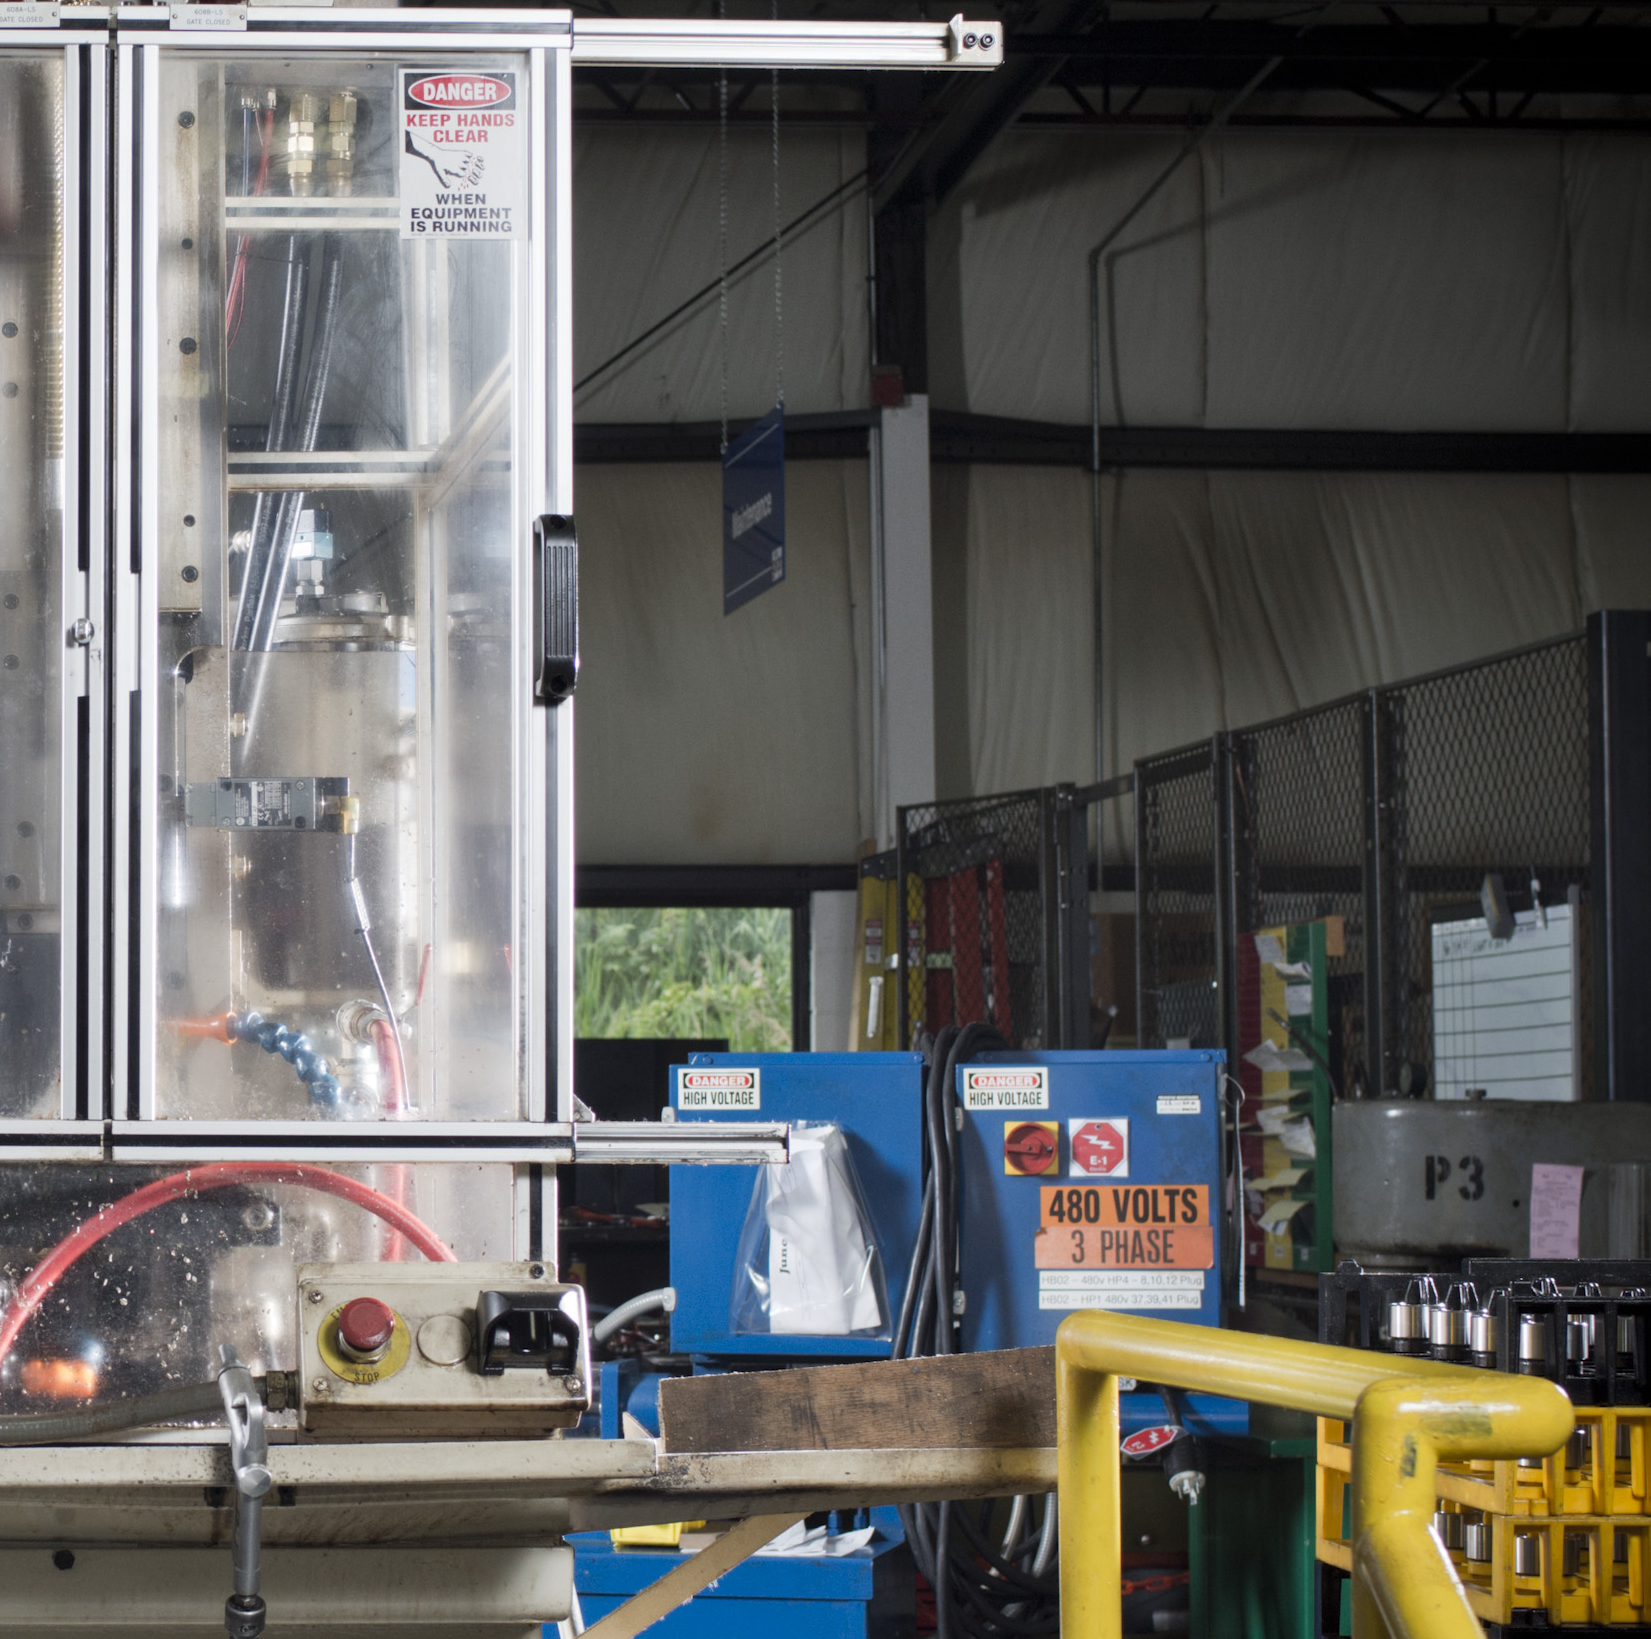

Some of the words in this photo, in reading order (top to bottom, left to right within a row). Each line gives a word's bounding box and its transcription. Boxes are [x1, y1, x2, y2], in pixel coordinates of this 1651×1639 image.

[423, 82, 497, 101] DANGER
[407, 114, 451, 127] KEEP
[457, 114, 515, 127] HANDS
[433, 130, 488, 143] CLEAR
[436, 194, 486, 205] WHEN
[411, 208, 512, 220] EQUIPMENT
[410, 221, 426, 232] IS
[432, 221, 512, 232] RUNNING
[691, 1074, 747, 1086] DANGER
[977, 1076, 1035, 1088] DANGER
[684, 1092, 707, 1105] HIGH
[711, 1092, 754, 1105] VOLTAGE
[969, 1092, 994, 1106] HIGH
[997, 1092, 1042, 1106] VOLTAGE
[1089, 1156, 1108, 1166] E-1
[1425, 1155, 1485, 1201] P3
[1049, 1189, 1100, 1224] 480
[1112, 1188, 1198, 1224] VOLTS
[1071, 1230, 1085, 1264] 3
[1101, 1230, 1175, 1264] PHASE
[1041, 1275, 1070, 1286] HB02
[1107, 1275, 1129, 1286] HP4
[1180, 1275, 1203, 1288] Plug
[1041, 1295, 1070, 1305] HB02
[1176, 1295, 1200, 1308] Plug
[353, 1371, 380, 1382] STOP
